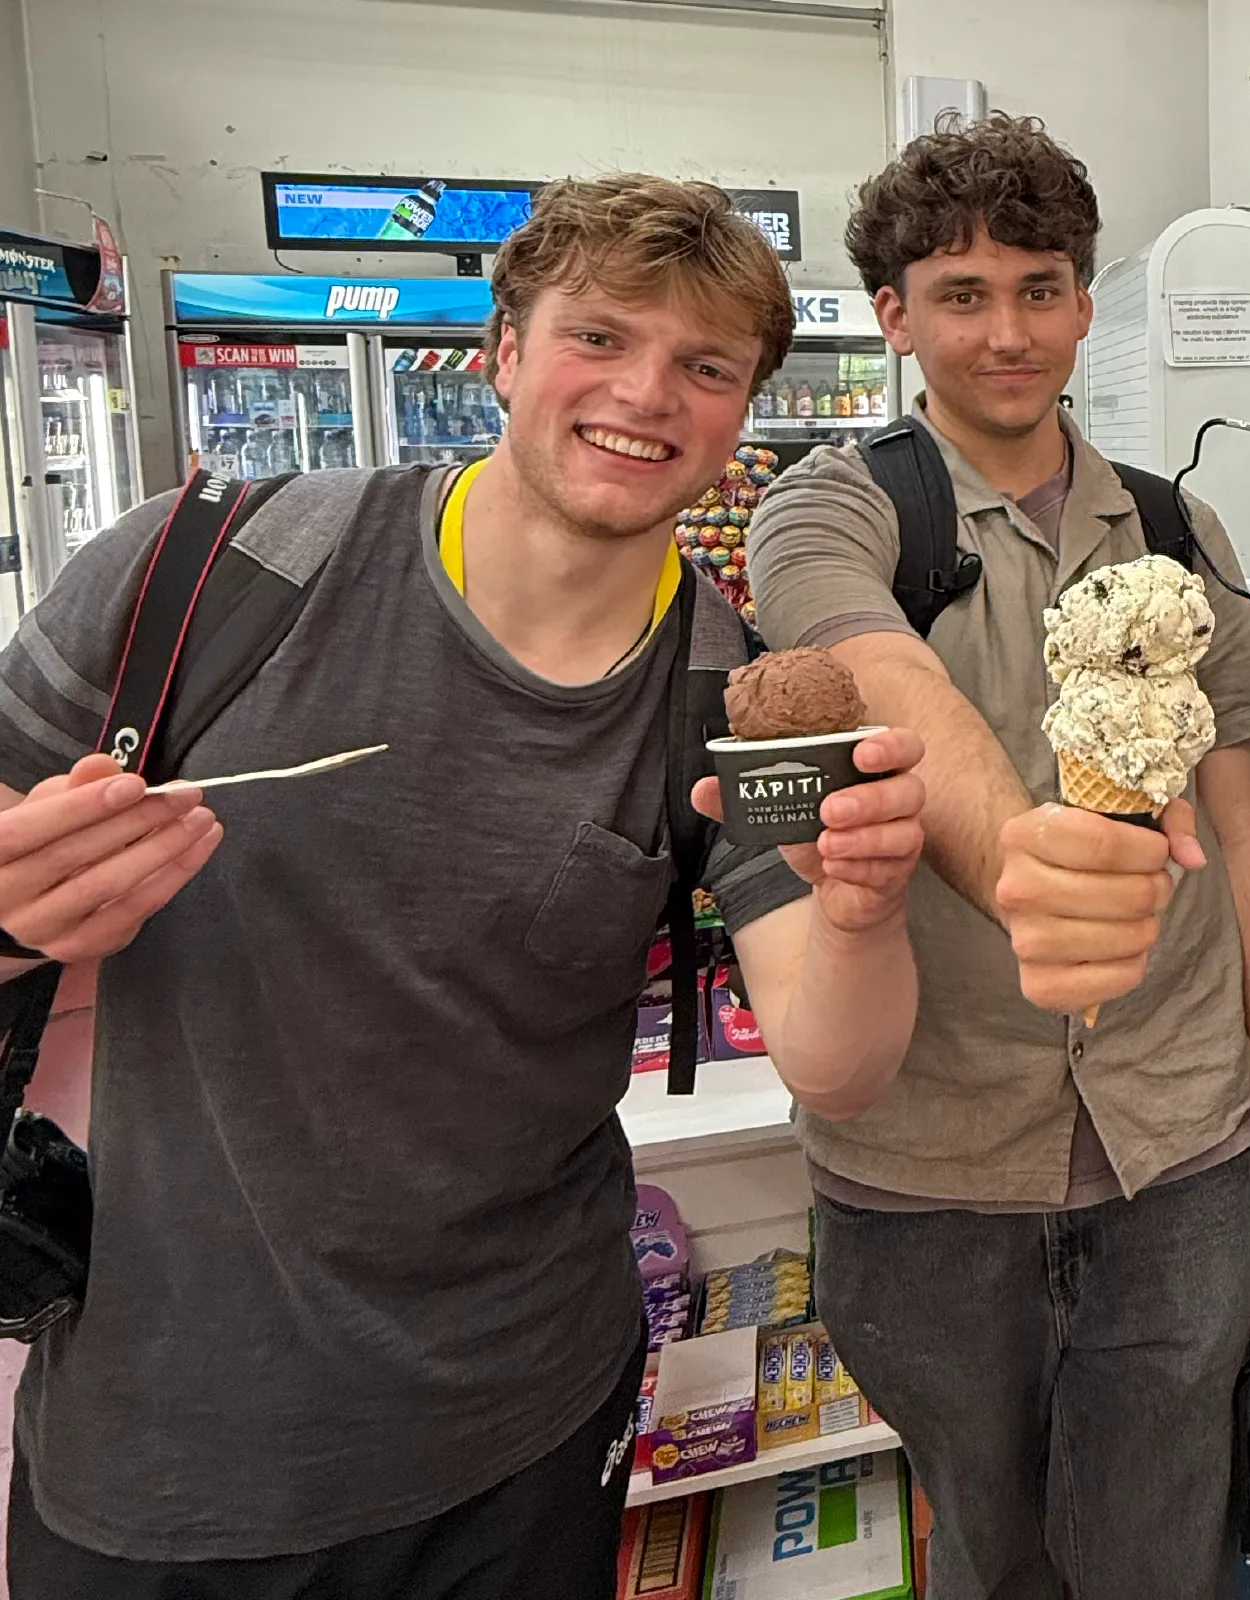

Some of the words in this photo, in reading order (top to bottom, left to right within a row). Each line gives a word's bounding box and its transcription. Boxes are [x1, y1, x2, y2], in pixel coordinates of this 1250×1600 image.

[284, 193, 323, 205] NEW
[216, 347, 249, 363] SCAN
[269, 348, 295, 363] WIN
[773, 802, 815, 812] ZEALAND
[747, 812, 816, 824] ORIGINAL
[680, 1440, 719, 1460] CHEW
